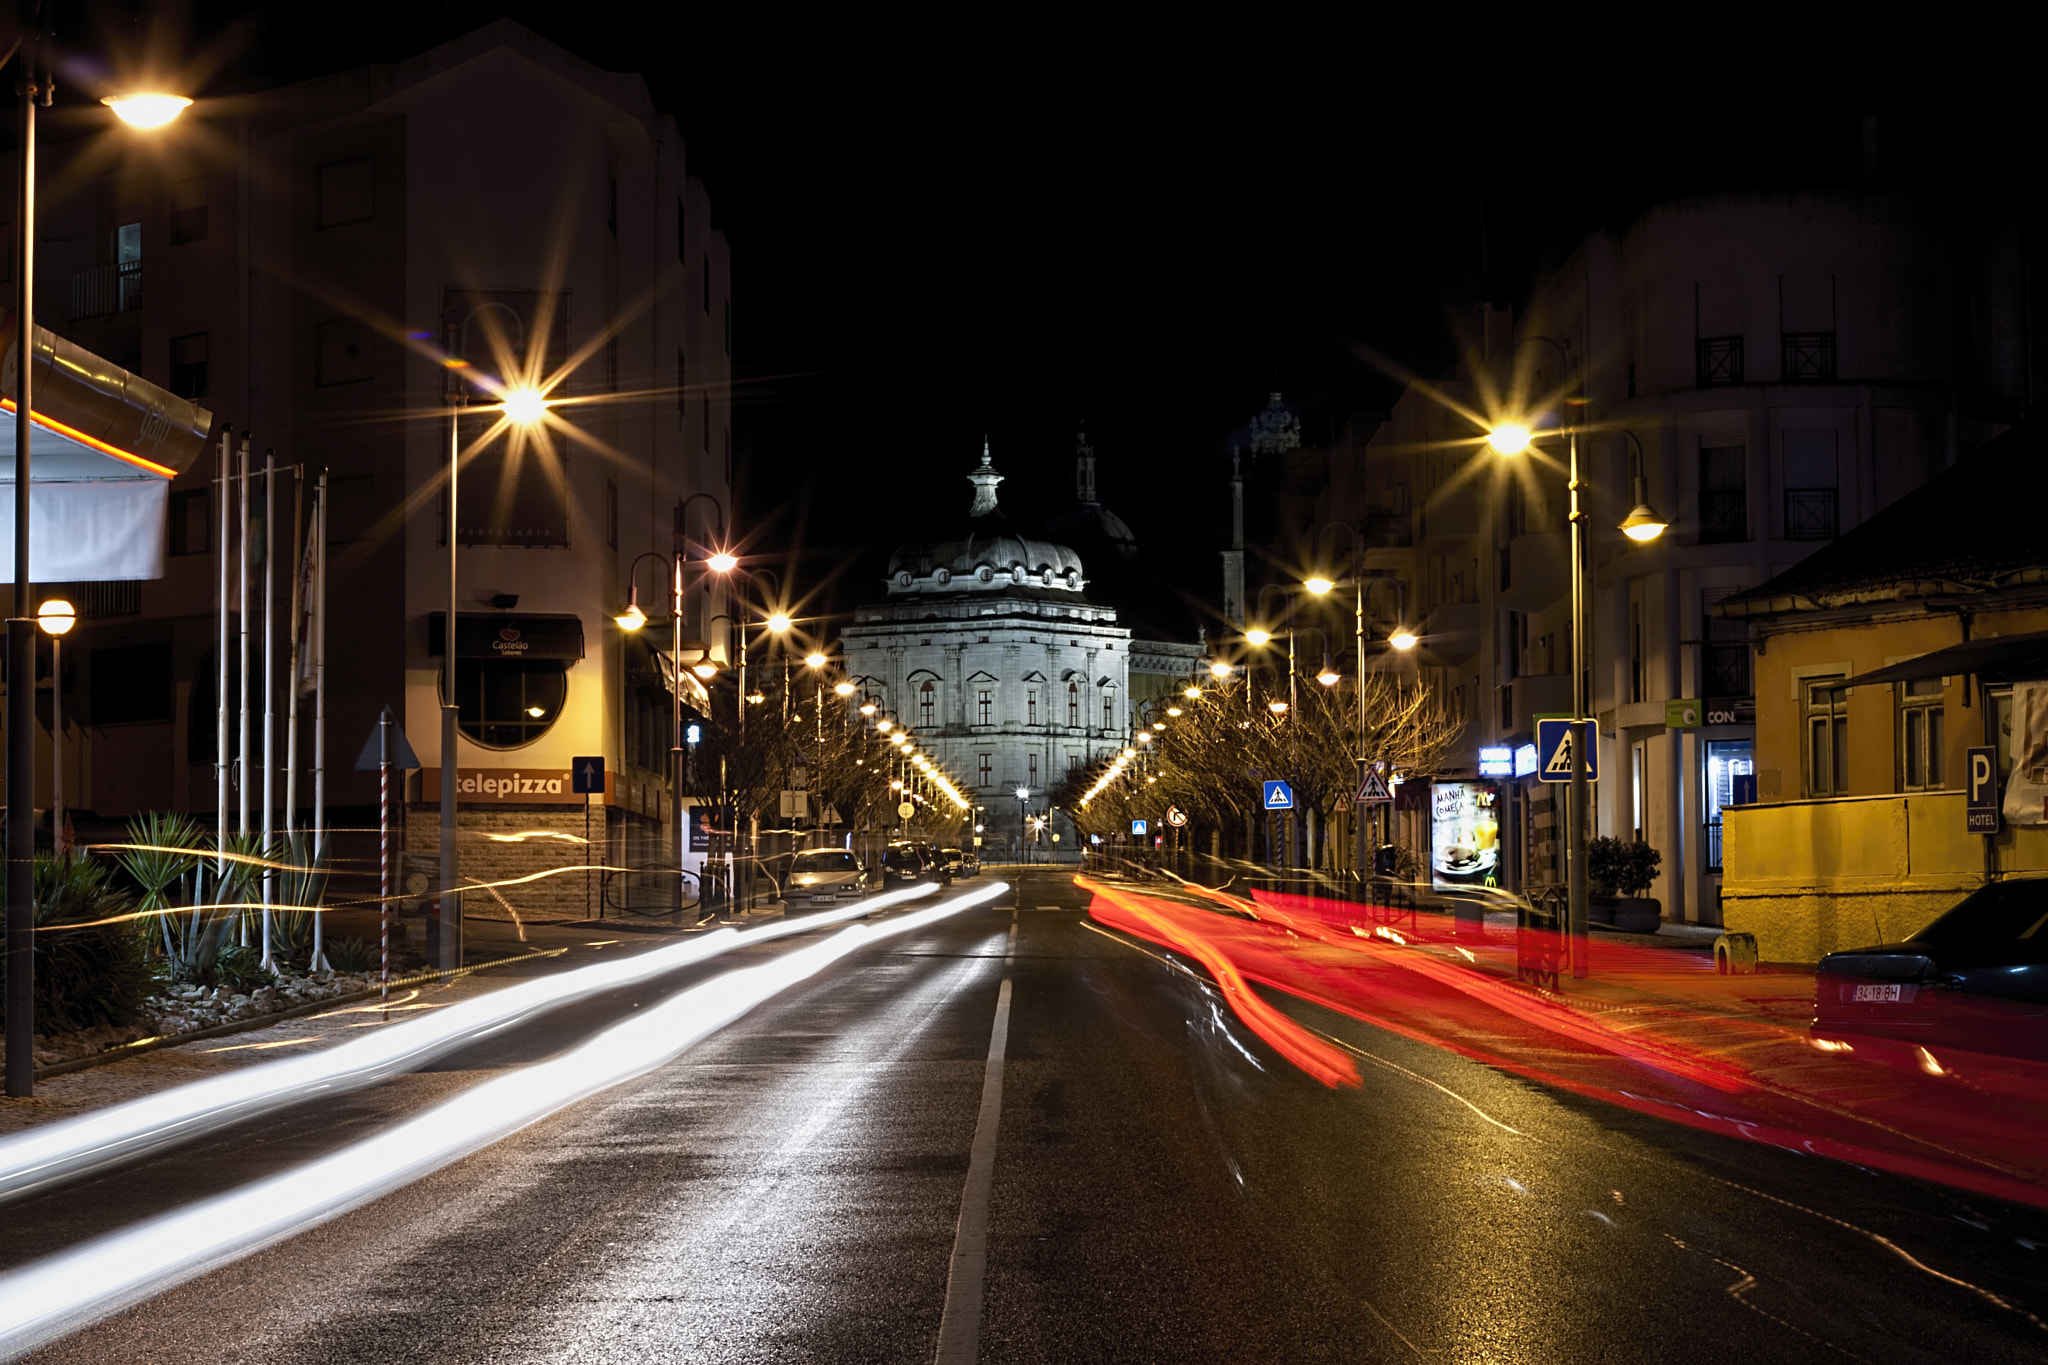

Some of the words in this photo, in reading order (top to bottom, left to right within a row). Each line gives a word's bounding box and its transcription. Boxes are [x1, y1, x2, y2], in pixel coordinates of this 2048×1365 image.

[456, 773, 562, 799] telepizza
[1972, 754, 1991, 802] P
[1436, 785, 1466, 805] MANHÃ
[1436, 802, 1464, 818] COMEÇA
[1968, 814, 1995, 826] HOTEL
